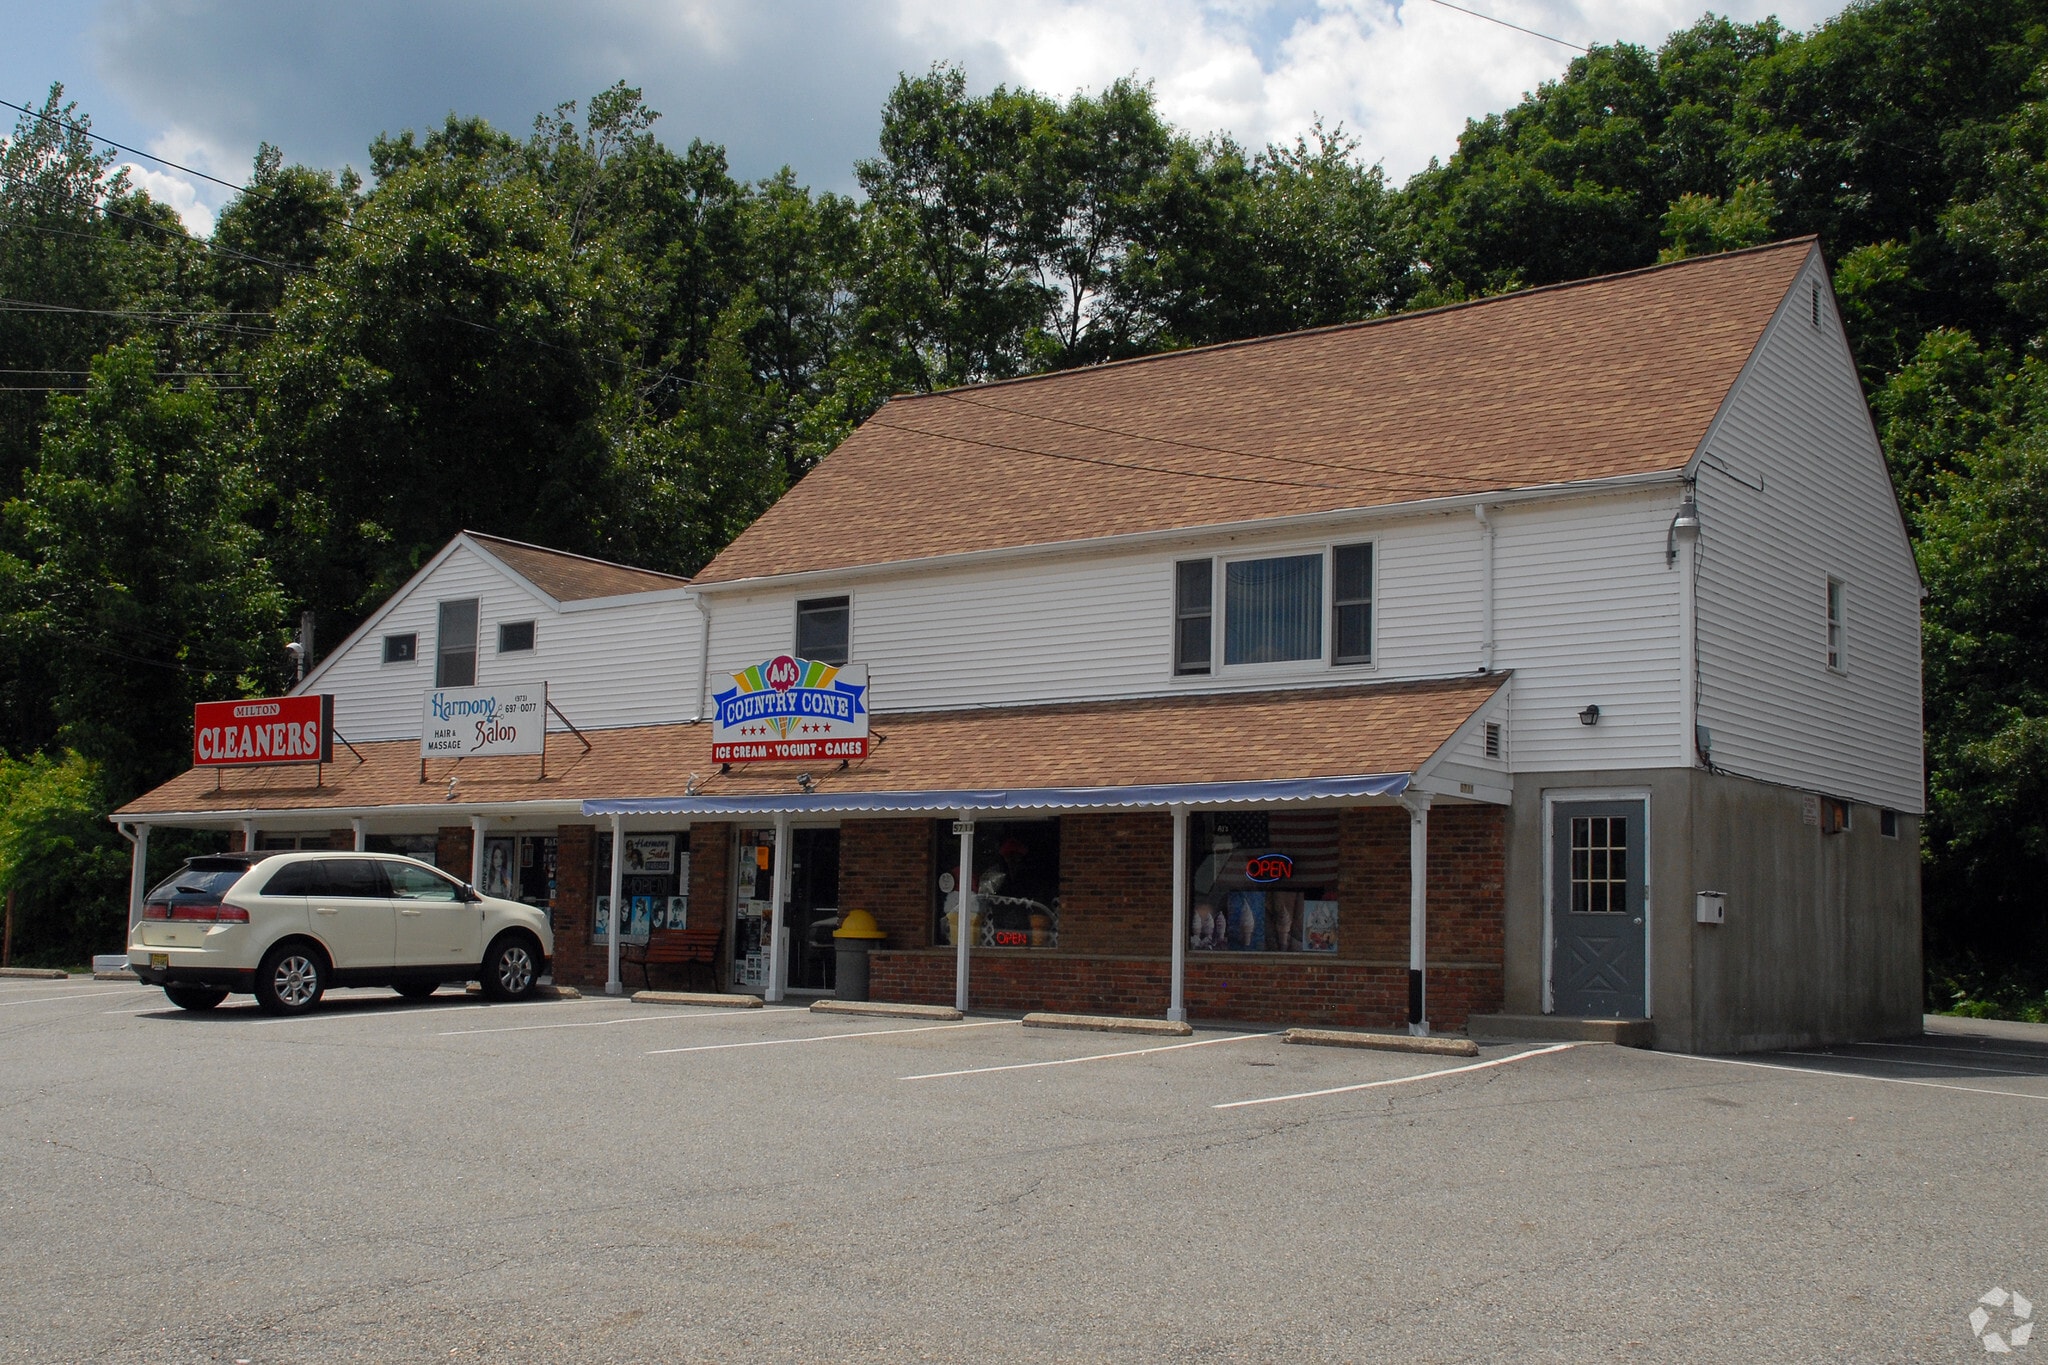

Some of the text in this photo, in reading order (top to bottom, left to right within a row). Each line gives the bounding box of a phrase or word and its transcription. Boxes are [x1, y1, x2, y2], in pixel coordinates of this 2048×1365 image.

[771, 662, 795, 683] AJ's
[236, 705, 278, 716] MILTON
[432, 693, 496, 723] Harmony
[505, 703, 537, 713] 697 0077
[726, 692, 849, 723] COUNTRY CONE
[198, 721, 317, 760] CLEANERS
[434, 730, 451, 738] HAIR
[470, 720, 516, 752] Salon
[428, 741, 461, 750] MASSAGE
[715, 742, 862, 759] ICE CREAM YOGURT CAKES
[635, 838, 669, 850] Harmony
[647, 848, 670, 859] Salon
[1246, 859, 1293, 879] OPEN
[996, 932, 1027, 945] OPEN
